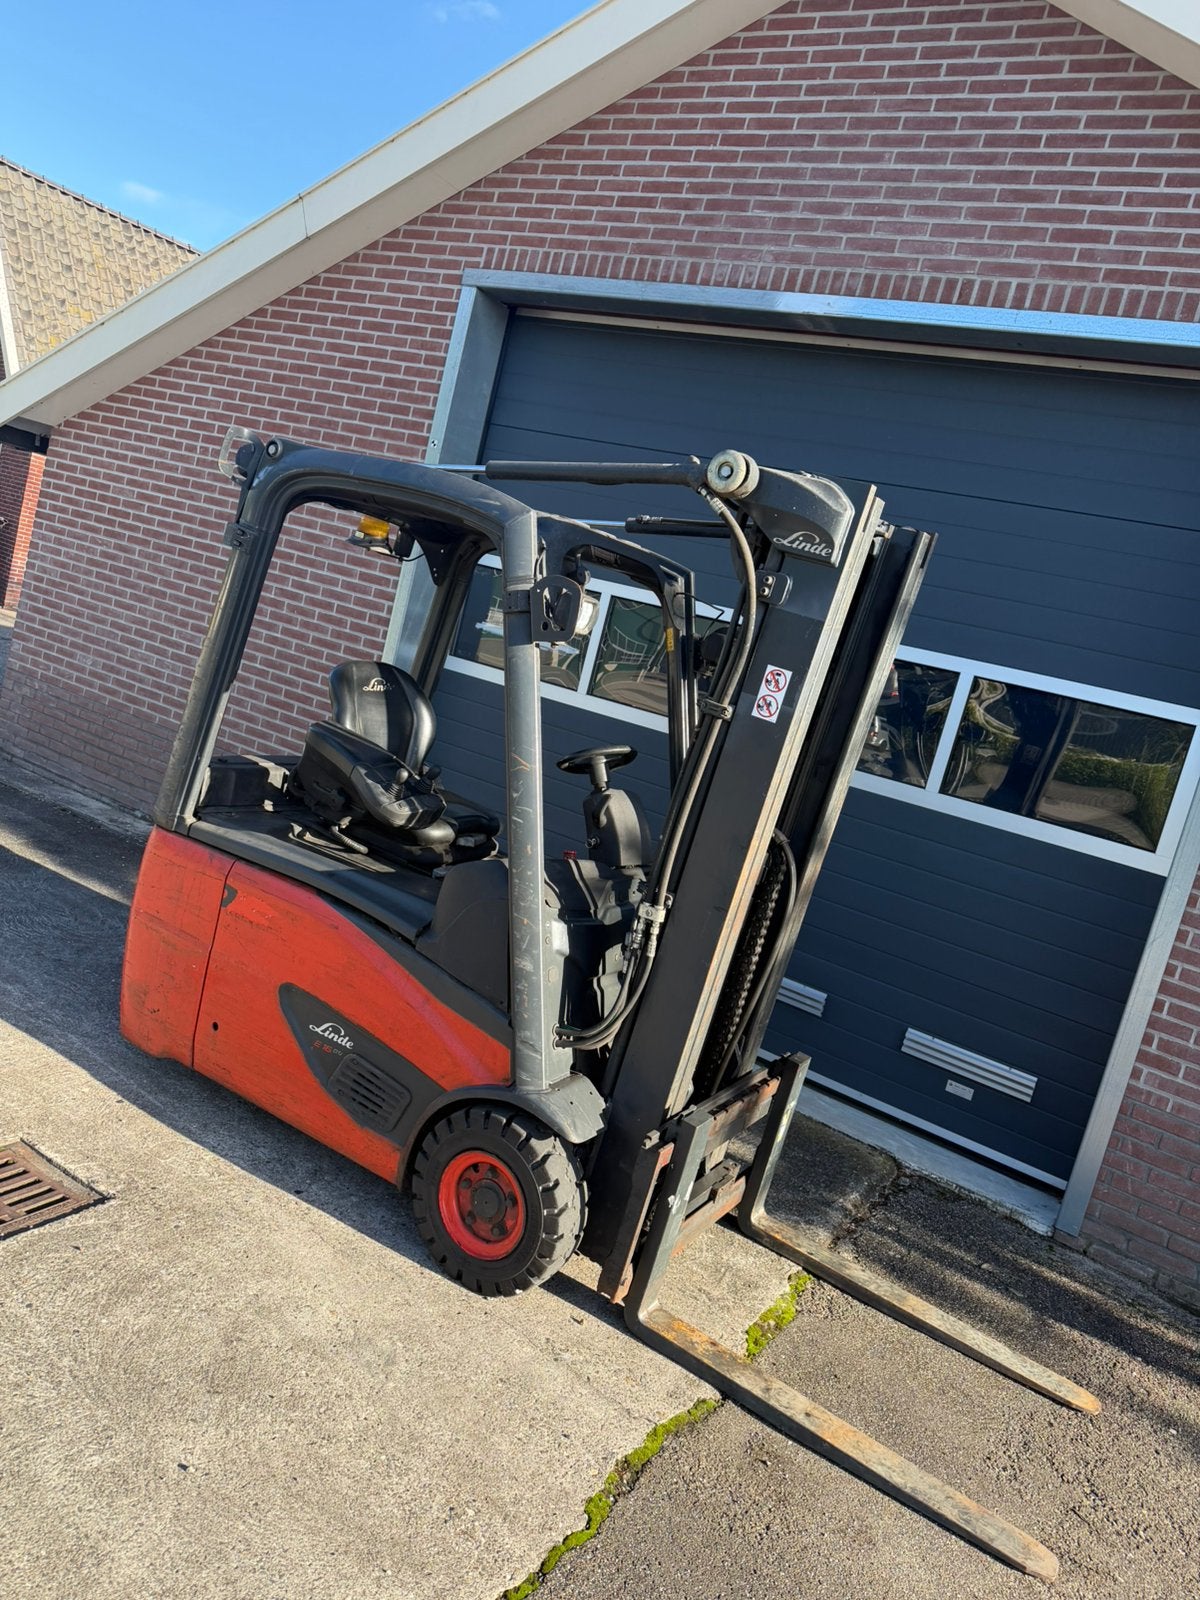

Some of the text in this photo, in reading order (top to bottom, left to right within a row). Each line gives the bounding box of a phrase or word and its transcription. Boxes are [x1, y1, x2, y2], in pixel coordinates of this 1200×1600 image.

[773, 531, 832, 557] Linde
[362, 677, 395, 692] Lin
[309, 1022, 354, 1050] Linde
